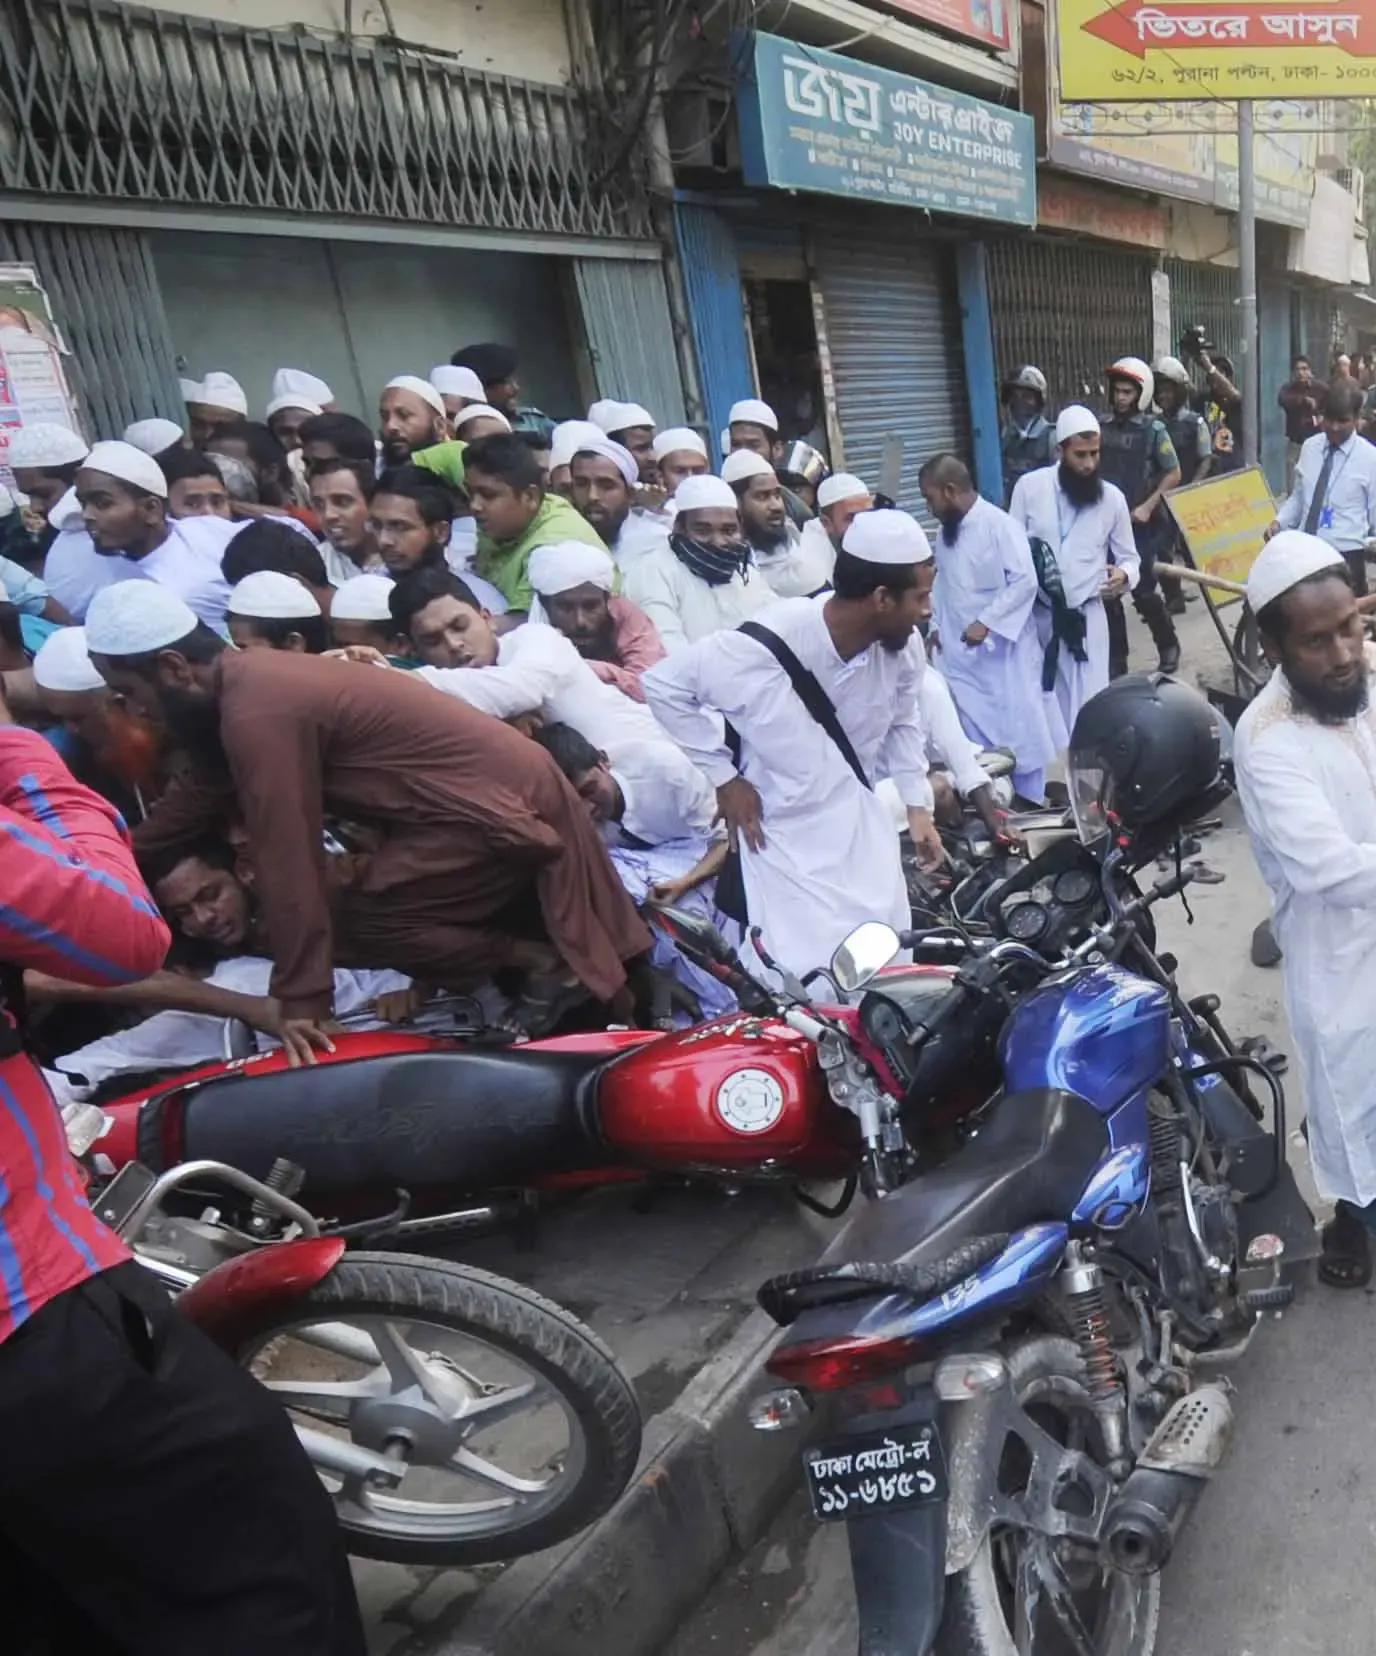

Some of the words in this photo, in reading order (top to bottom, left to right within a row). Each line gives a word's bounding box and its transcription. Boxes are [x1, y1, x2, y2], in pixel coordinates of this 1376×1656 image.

[1133, 9, 1249, 41] ভিতরে
[1260, 12, 1360, 44] আসুন
[893, 120, 924, 145] JOY
[929, 131, 1023, 170] ENTERPRISE
[941, 1273, 980, 1310] 135
[810, 1454, 853, 1480] ঢাকা
[855, 1437, 931, 1473] মেট্রো-ল
[819, 1469, 937, 1512] ১১-৬৮৫১
